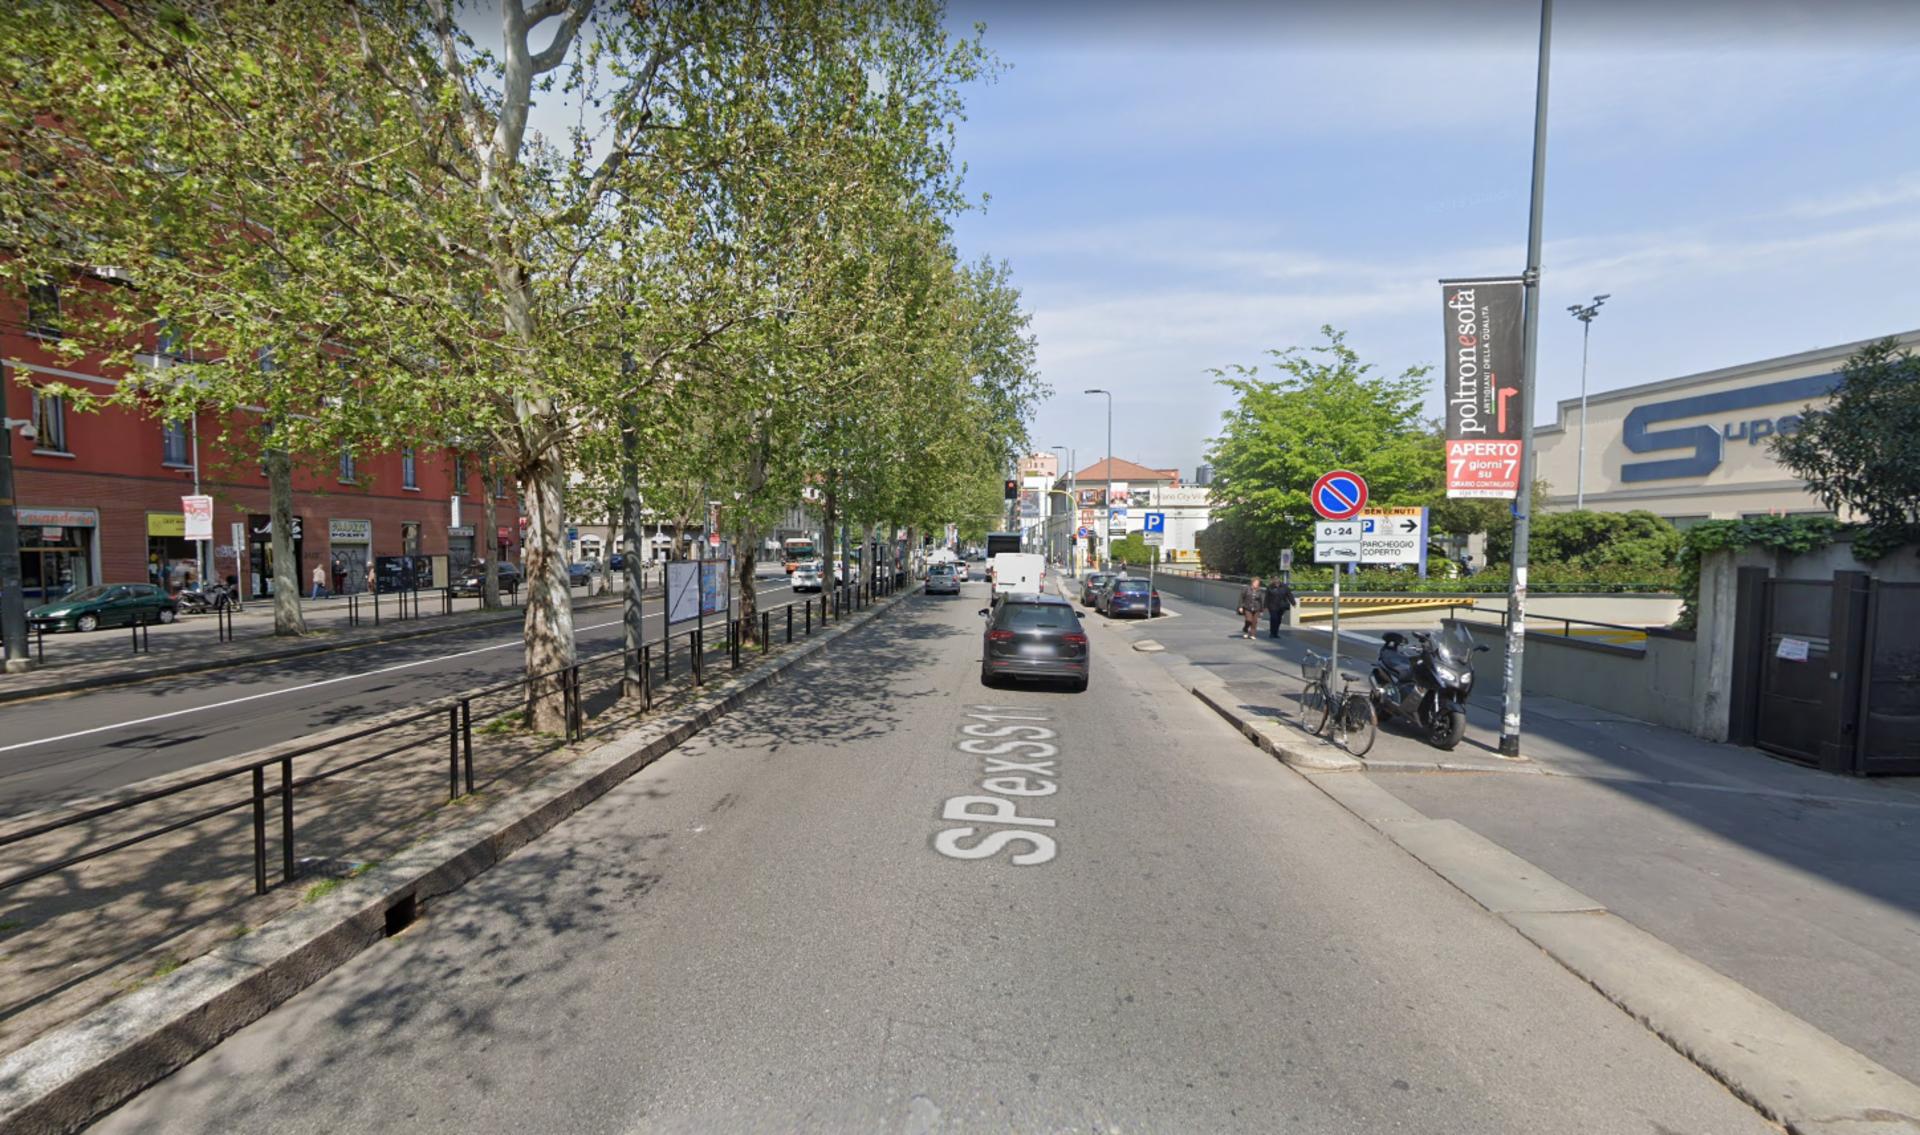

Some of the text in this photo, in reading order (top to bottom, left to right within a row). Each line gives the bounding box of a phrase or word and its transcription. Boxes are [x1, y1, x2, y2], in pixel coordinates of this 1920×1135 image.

[1482, 343, 1491, 369] DELLA
[1450, 443, 1519, 457] APERTO
[1450, 459, 1466, 479] 7
[1469, 460, 1502, 471] giorni
[1503, 459, 1517, 479] 7
[1149, 516, 1160, 529] P
[1362, 521, 1371, 531] P
[1362, 540, 1414, 548] PARCHEGGIO
